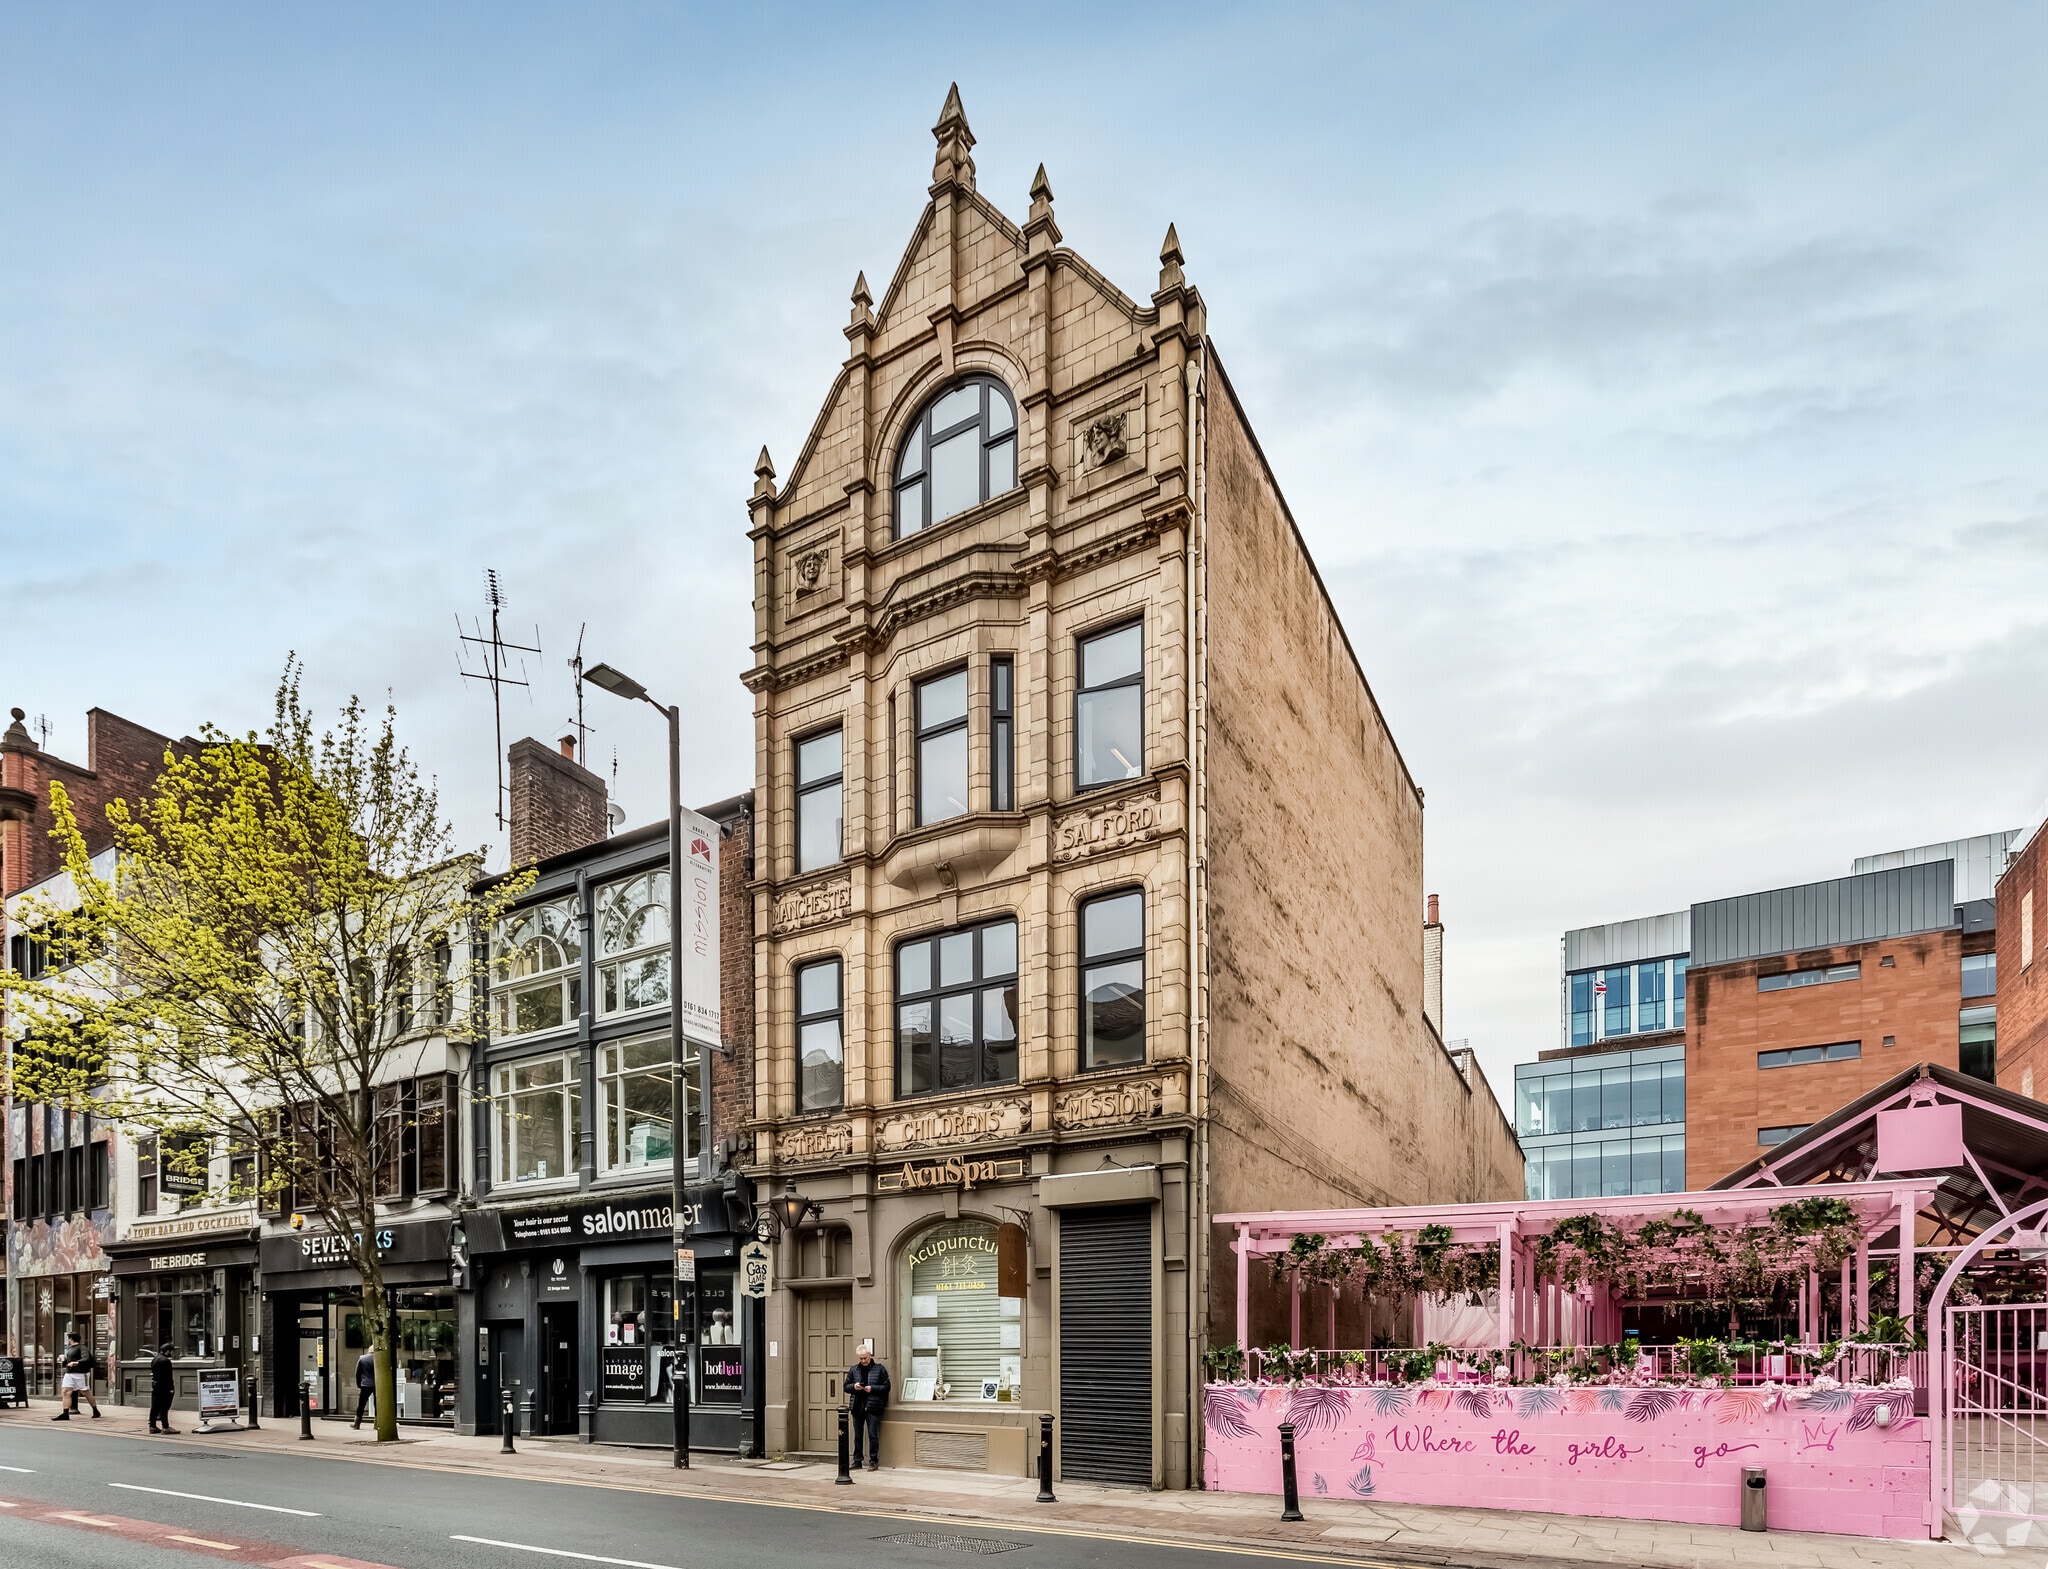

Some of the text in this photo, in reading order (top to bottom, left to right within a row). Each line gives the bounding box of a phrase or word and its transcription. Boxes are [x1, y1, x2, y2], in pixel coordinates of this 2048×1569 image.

[1062, 807, 1154, 851] SALFORD
[683, 1000, 696, 1011] 0161
[697, 1005, 708, 1016] 834
[708, 1009, 720, 1021] 1717
[1069, 1090, 1149, 1122] MISSION
[786, 1130, 845, 1157] STREET
[165, 1174, 204, 1186] BRIDGE
[898, 1155, 999, 1190] AcuSpa
[133, 1214, 249, 1238] TOWN BAR AND COCKTAILS
[582, 1203, 702, 1235] salonmaer
[149, 1252, 207, 1270] THE BRIDGE
[312, 1255, 340, 1263] SOUND
[746, 1261, 767, 1276] Gas
[941, 1253, 978, 1278] 針灸
[748, 1274, 767, 1284] LAMP
[605, 1364, 644, 1381] image
[1385, 1425, 1760, 1469] Where the girls go
